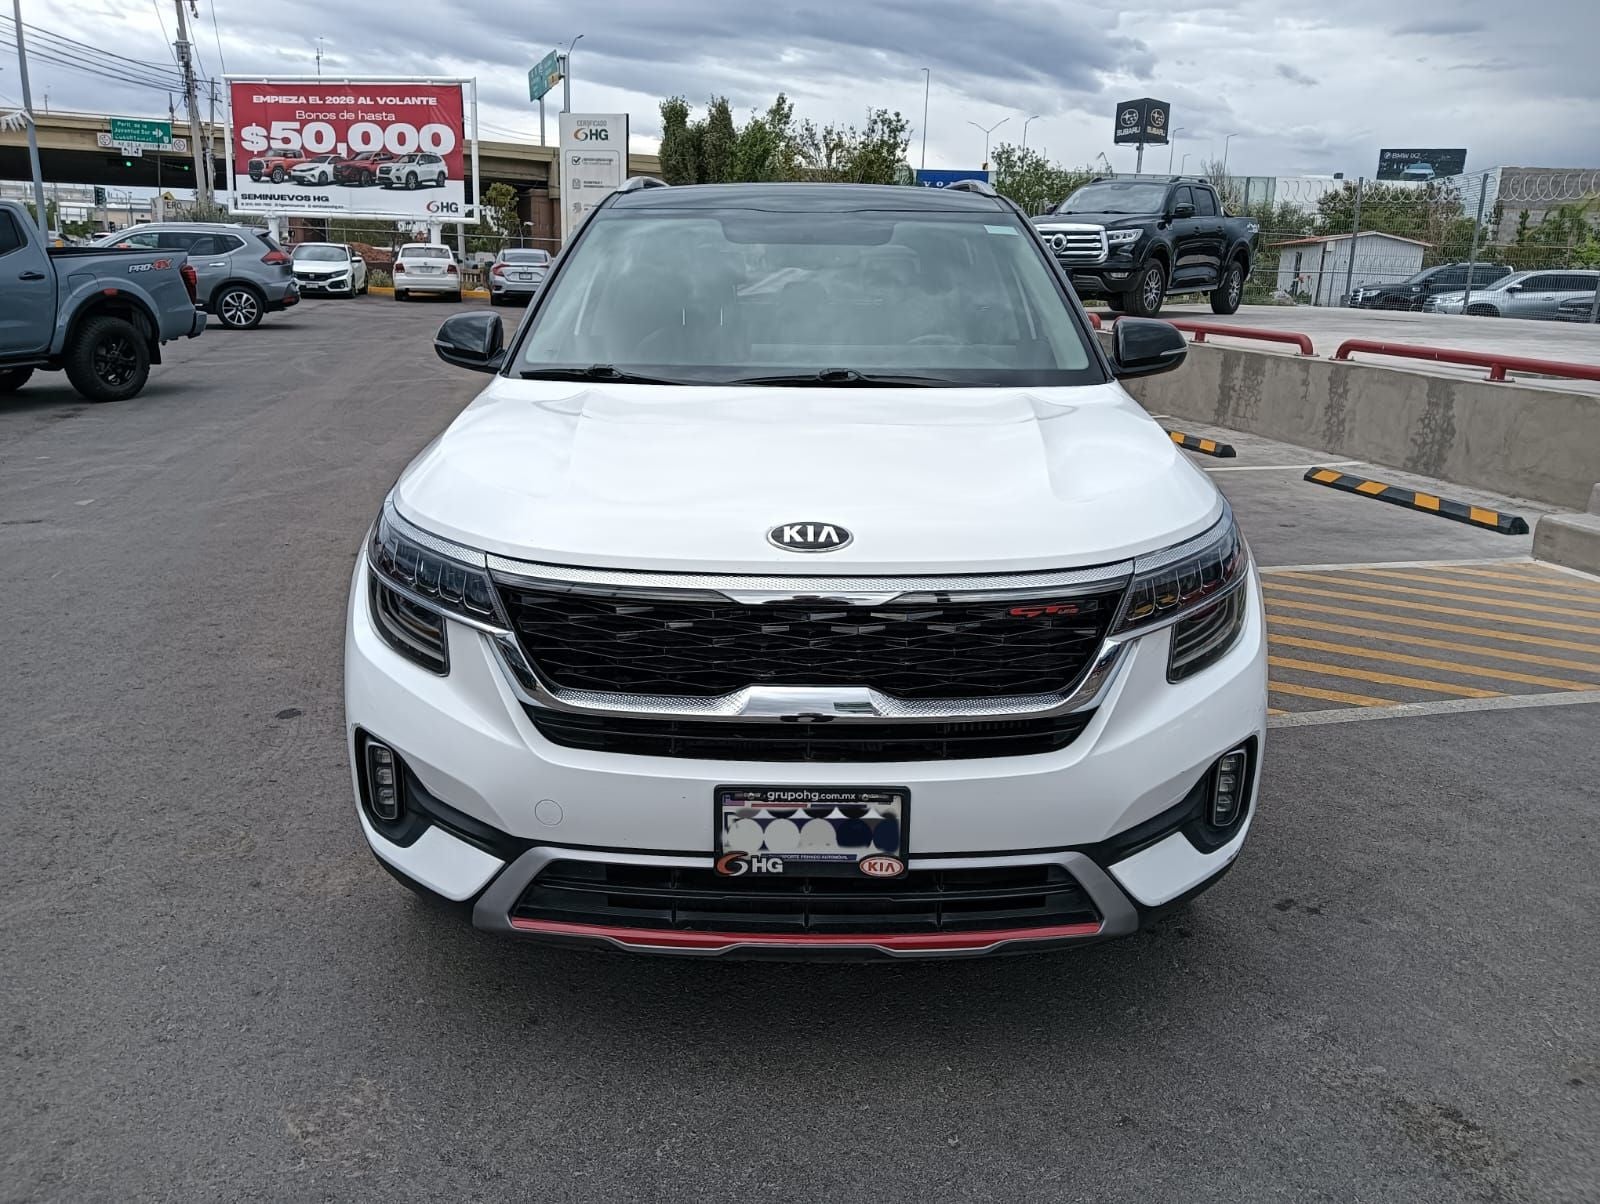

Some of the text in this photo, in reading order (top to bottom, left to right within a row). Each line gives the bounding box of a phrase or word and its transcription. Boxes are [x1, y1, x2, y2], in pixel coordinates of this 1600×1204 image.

[252, 95, 438, 105] EMPIEZA EL 2026 AL VOLANTE
[295, 110, 396, 121] Bonos de hasta
[588, 128, 609, 141] HG
[1116, 126, 1141, 136] SUBARU
[240, 120, 456, 159] $50,000
[240, 193, 311, 202] SEMINUEVOS
[440, 201, 459, 213] HG
[783, 525, 840, 543] KIA
[767, 790, 856, 801] grupohg.com.mx
[751, 857, 784, 873] HG
[867, 862, 896, 873] KIA
